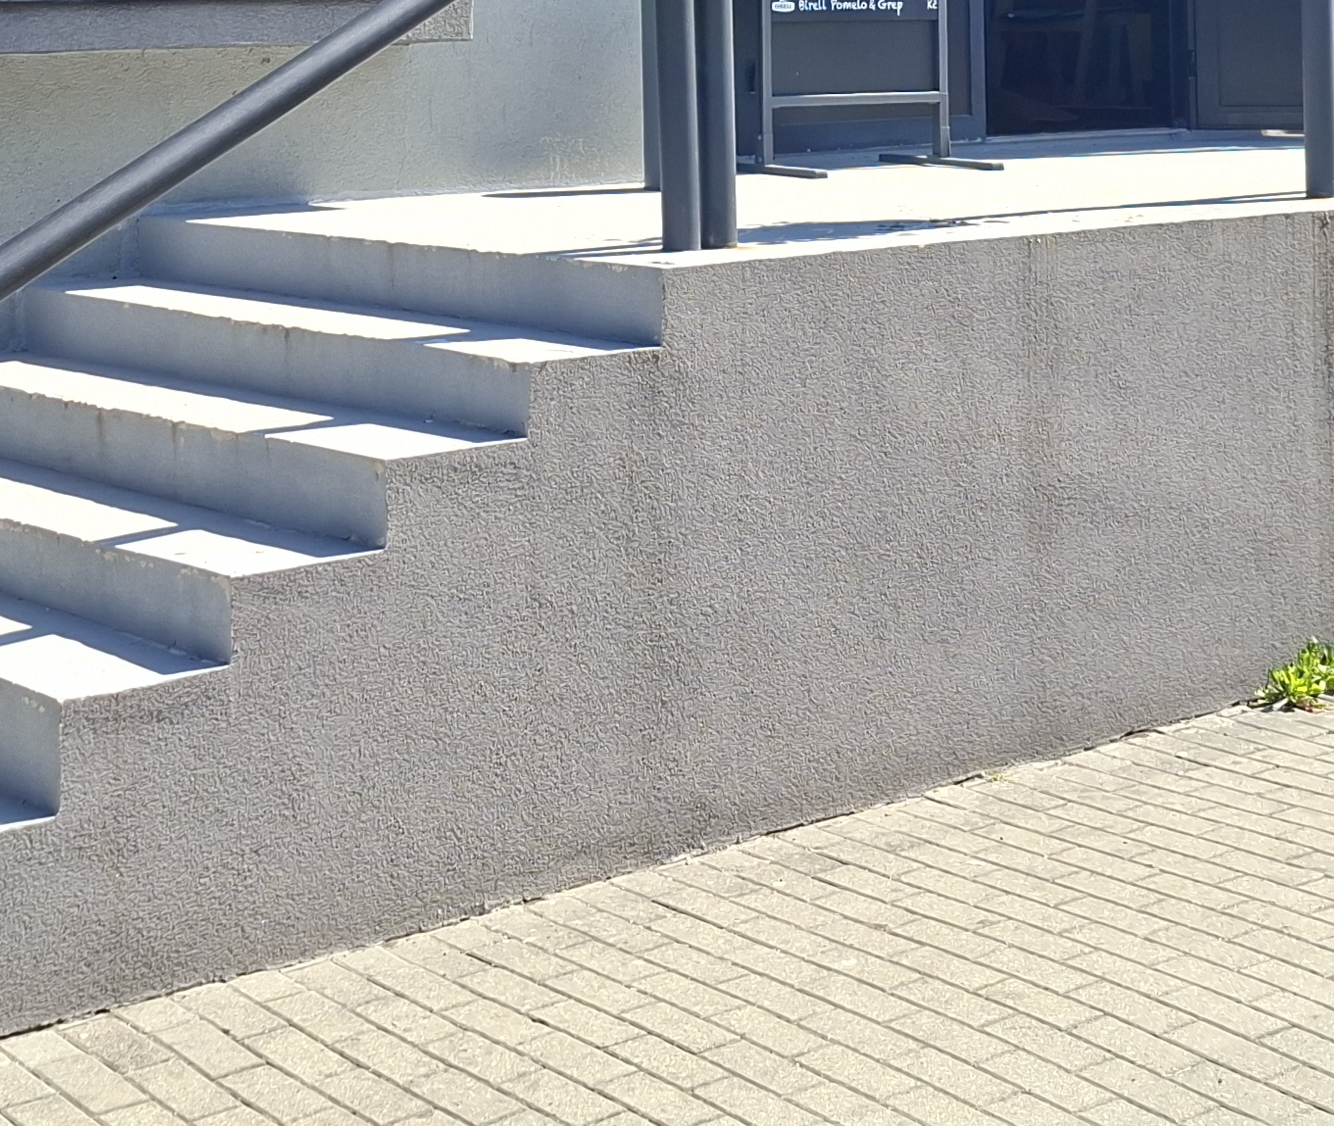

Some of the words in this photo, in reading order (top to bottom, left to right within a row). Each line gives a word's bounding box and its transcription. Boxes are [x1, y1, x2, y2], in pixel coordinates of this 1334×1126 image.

[798, 0, 827, 11] Birell
[868, 0, 876, 11] &
[926, 0, 938, 10] Kč
